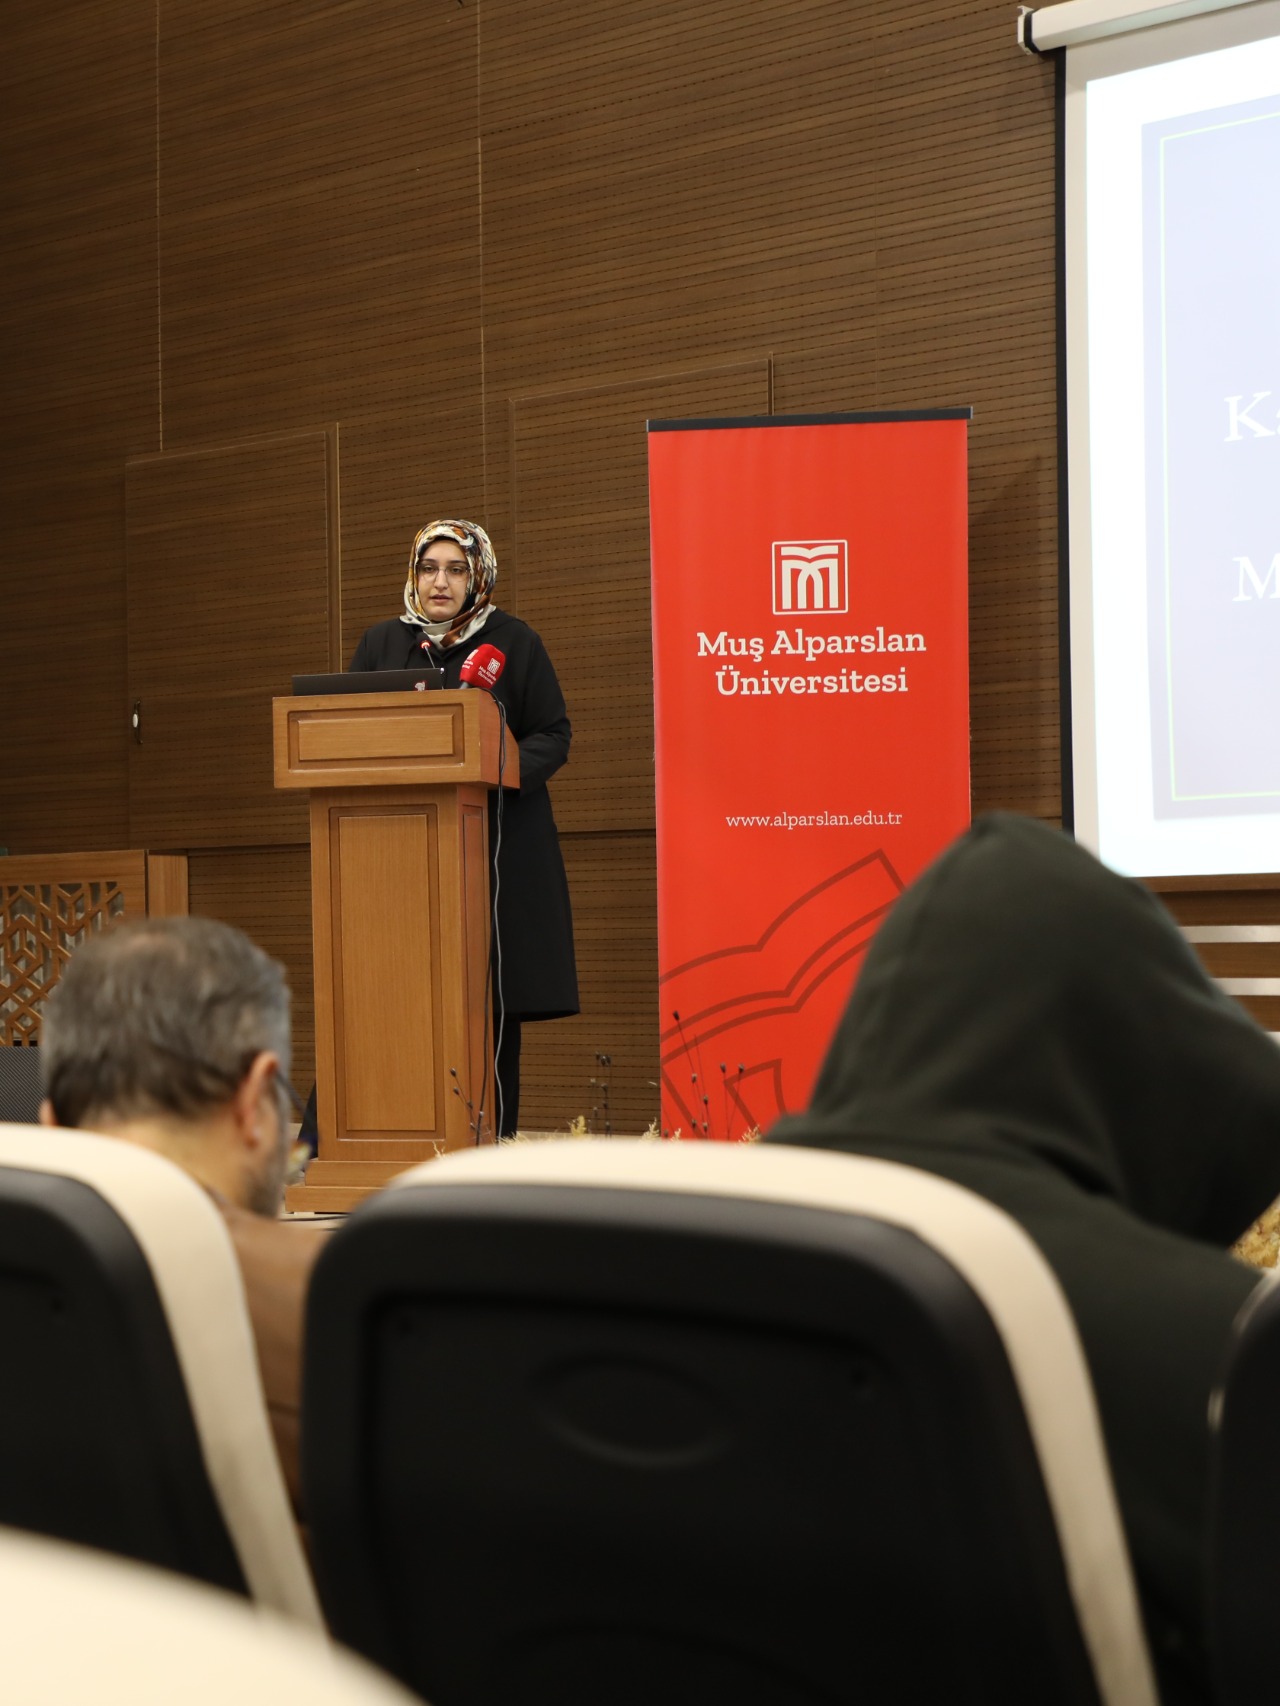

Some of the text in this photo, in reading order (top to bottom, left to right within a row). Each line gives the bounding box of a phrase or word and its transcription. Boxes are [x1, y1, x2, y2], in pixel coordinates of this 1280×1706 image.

[696, 626, 927, 663] Muş Alparslan
[715, 664, 909, 696] Üniversitesi
[725, 810, 903, 831] www.alparslan.edu.tr
